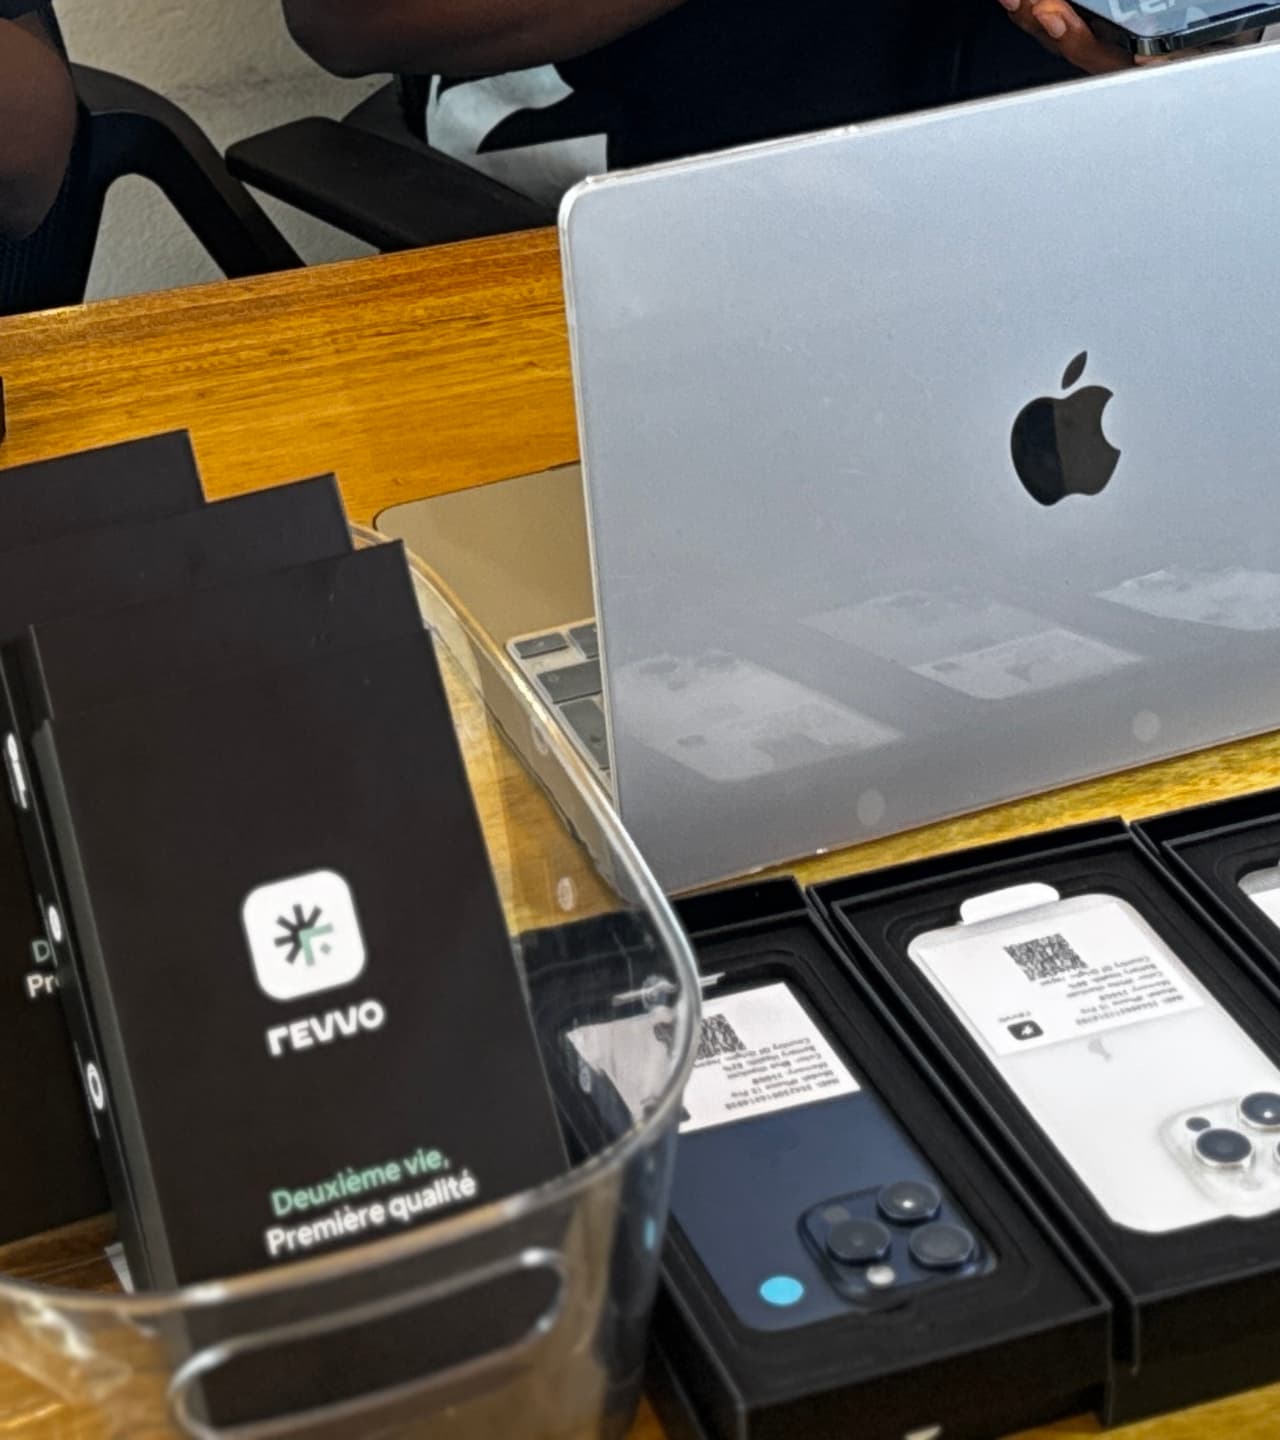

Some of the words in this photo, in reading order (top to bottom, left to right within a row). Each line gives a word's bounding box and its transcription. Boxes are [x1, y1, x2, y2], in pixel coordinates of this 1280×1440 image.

[266, 1206, 385, 1256] Première
[388, 1168, 477, 1223] qualité
[271, 1168, 401, 1216] Deuxième
